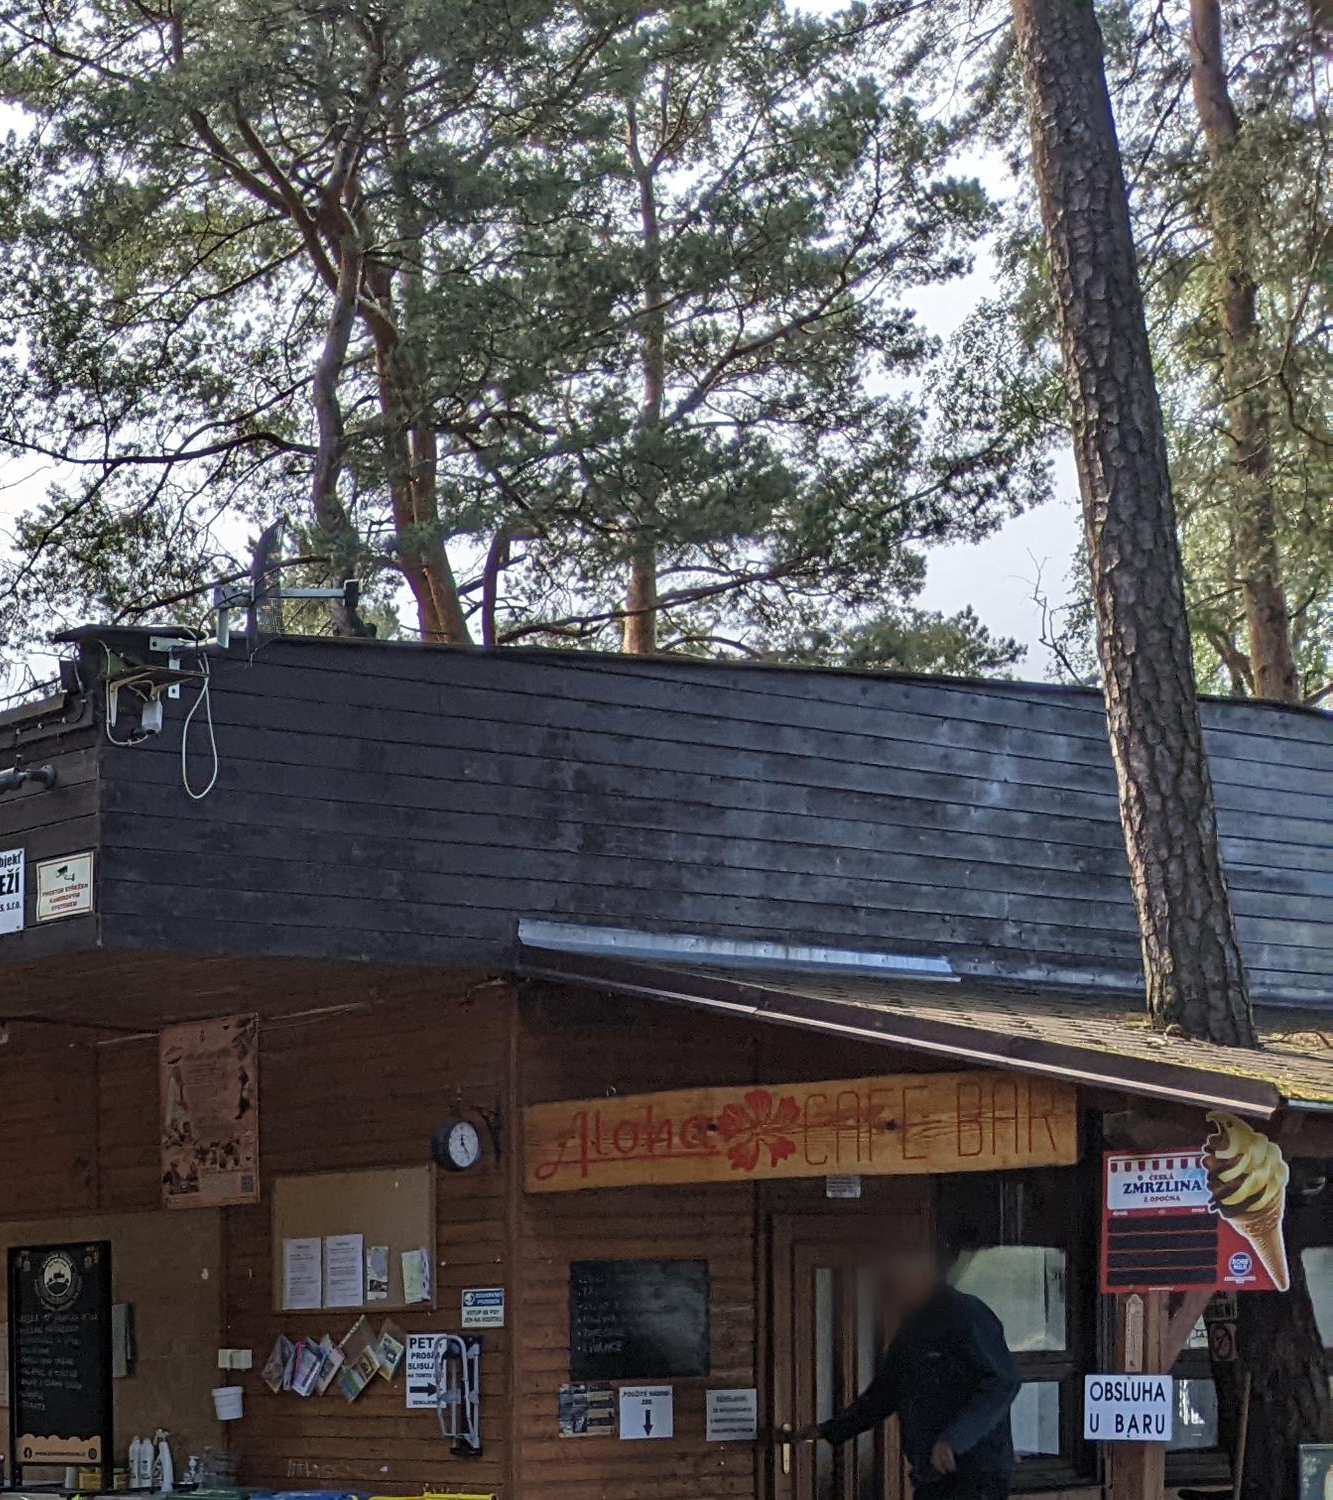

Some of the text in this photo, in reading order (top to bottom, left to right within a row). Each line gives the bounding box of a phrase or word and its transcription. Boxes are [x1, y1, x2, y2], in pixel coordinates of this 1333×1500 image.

[535, 1078, 1059, 1180] Aloha CAFE BAR
[1149, 1173, 1174, 1181] ČESKÁ
[1123, 1179, 1203, 1195] ZMRZLINA
[409, 1337, 434, 1349] PET
[1089, 1381, 1166, 1402] OBSLUHA
[1089, 1413, 1165, 1435] U BARU
